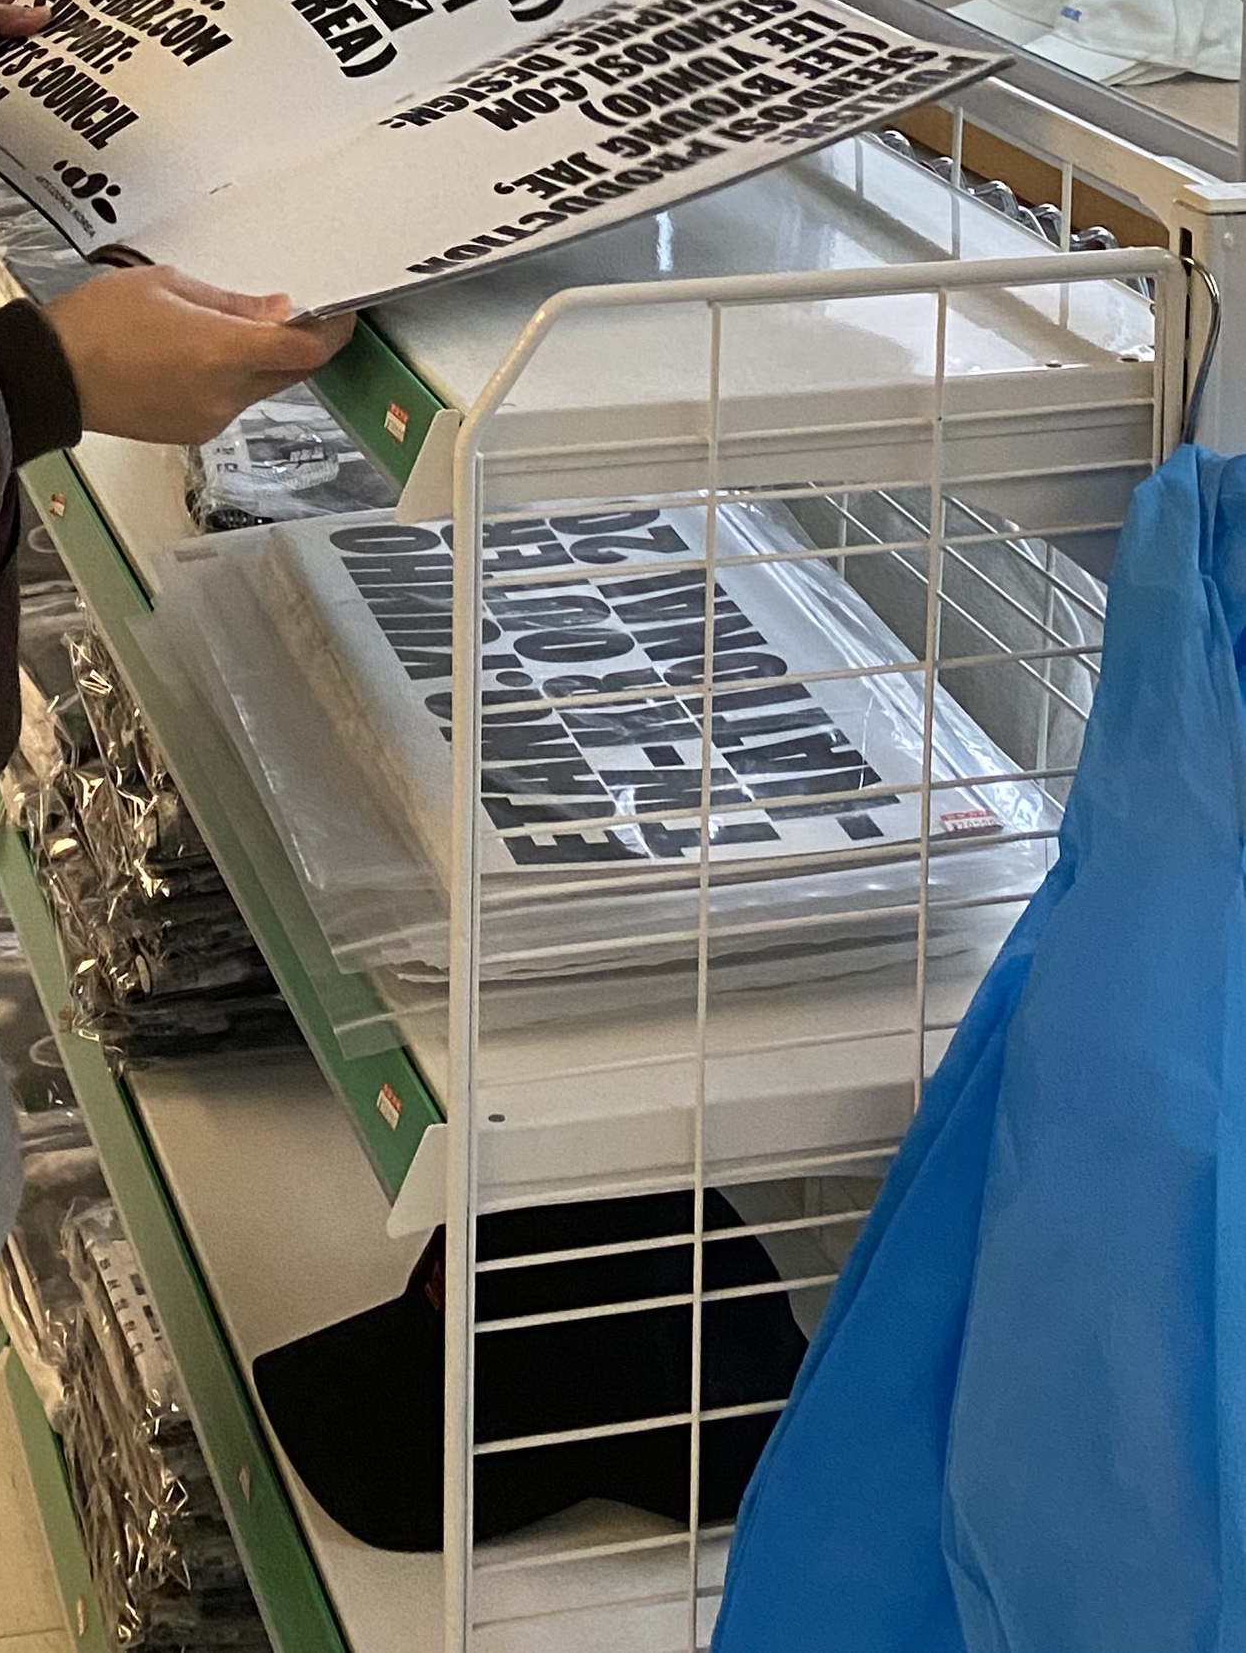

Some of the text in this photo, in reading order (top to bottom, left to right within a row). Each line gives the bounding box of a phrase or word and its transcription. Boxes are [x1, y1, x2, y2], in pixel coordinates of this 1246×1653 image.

[18, 57, 140, 150] COUNCIL
[378, 53, 567, 130] DESIGN:
[494, 30, 890, 199] (LEE BYOUNG JAE,
[578, 10, 847, 127] LEE YUNHO)
[406, 45, 939, 275] SEENDOSI PRODUCTION
